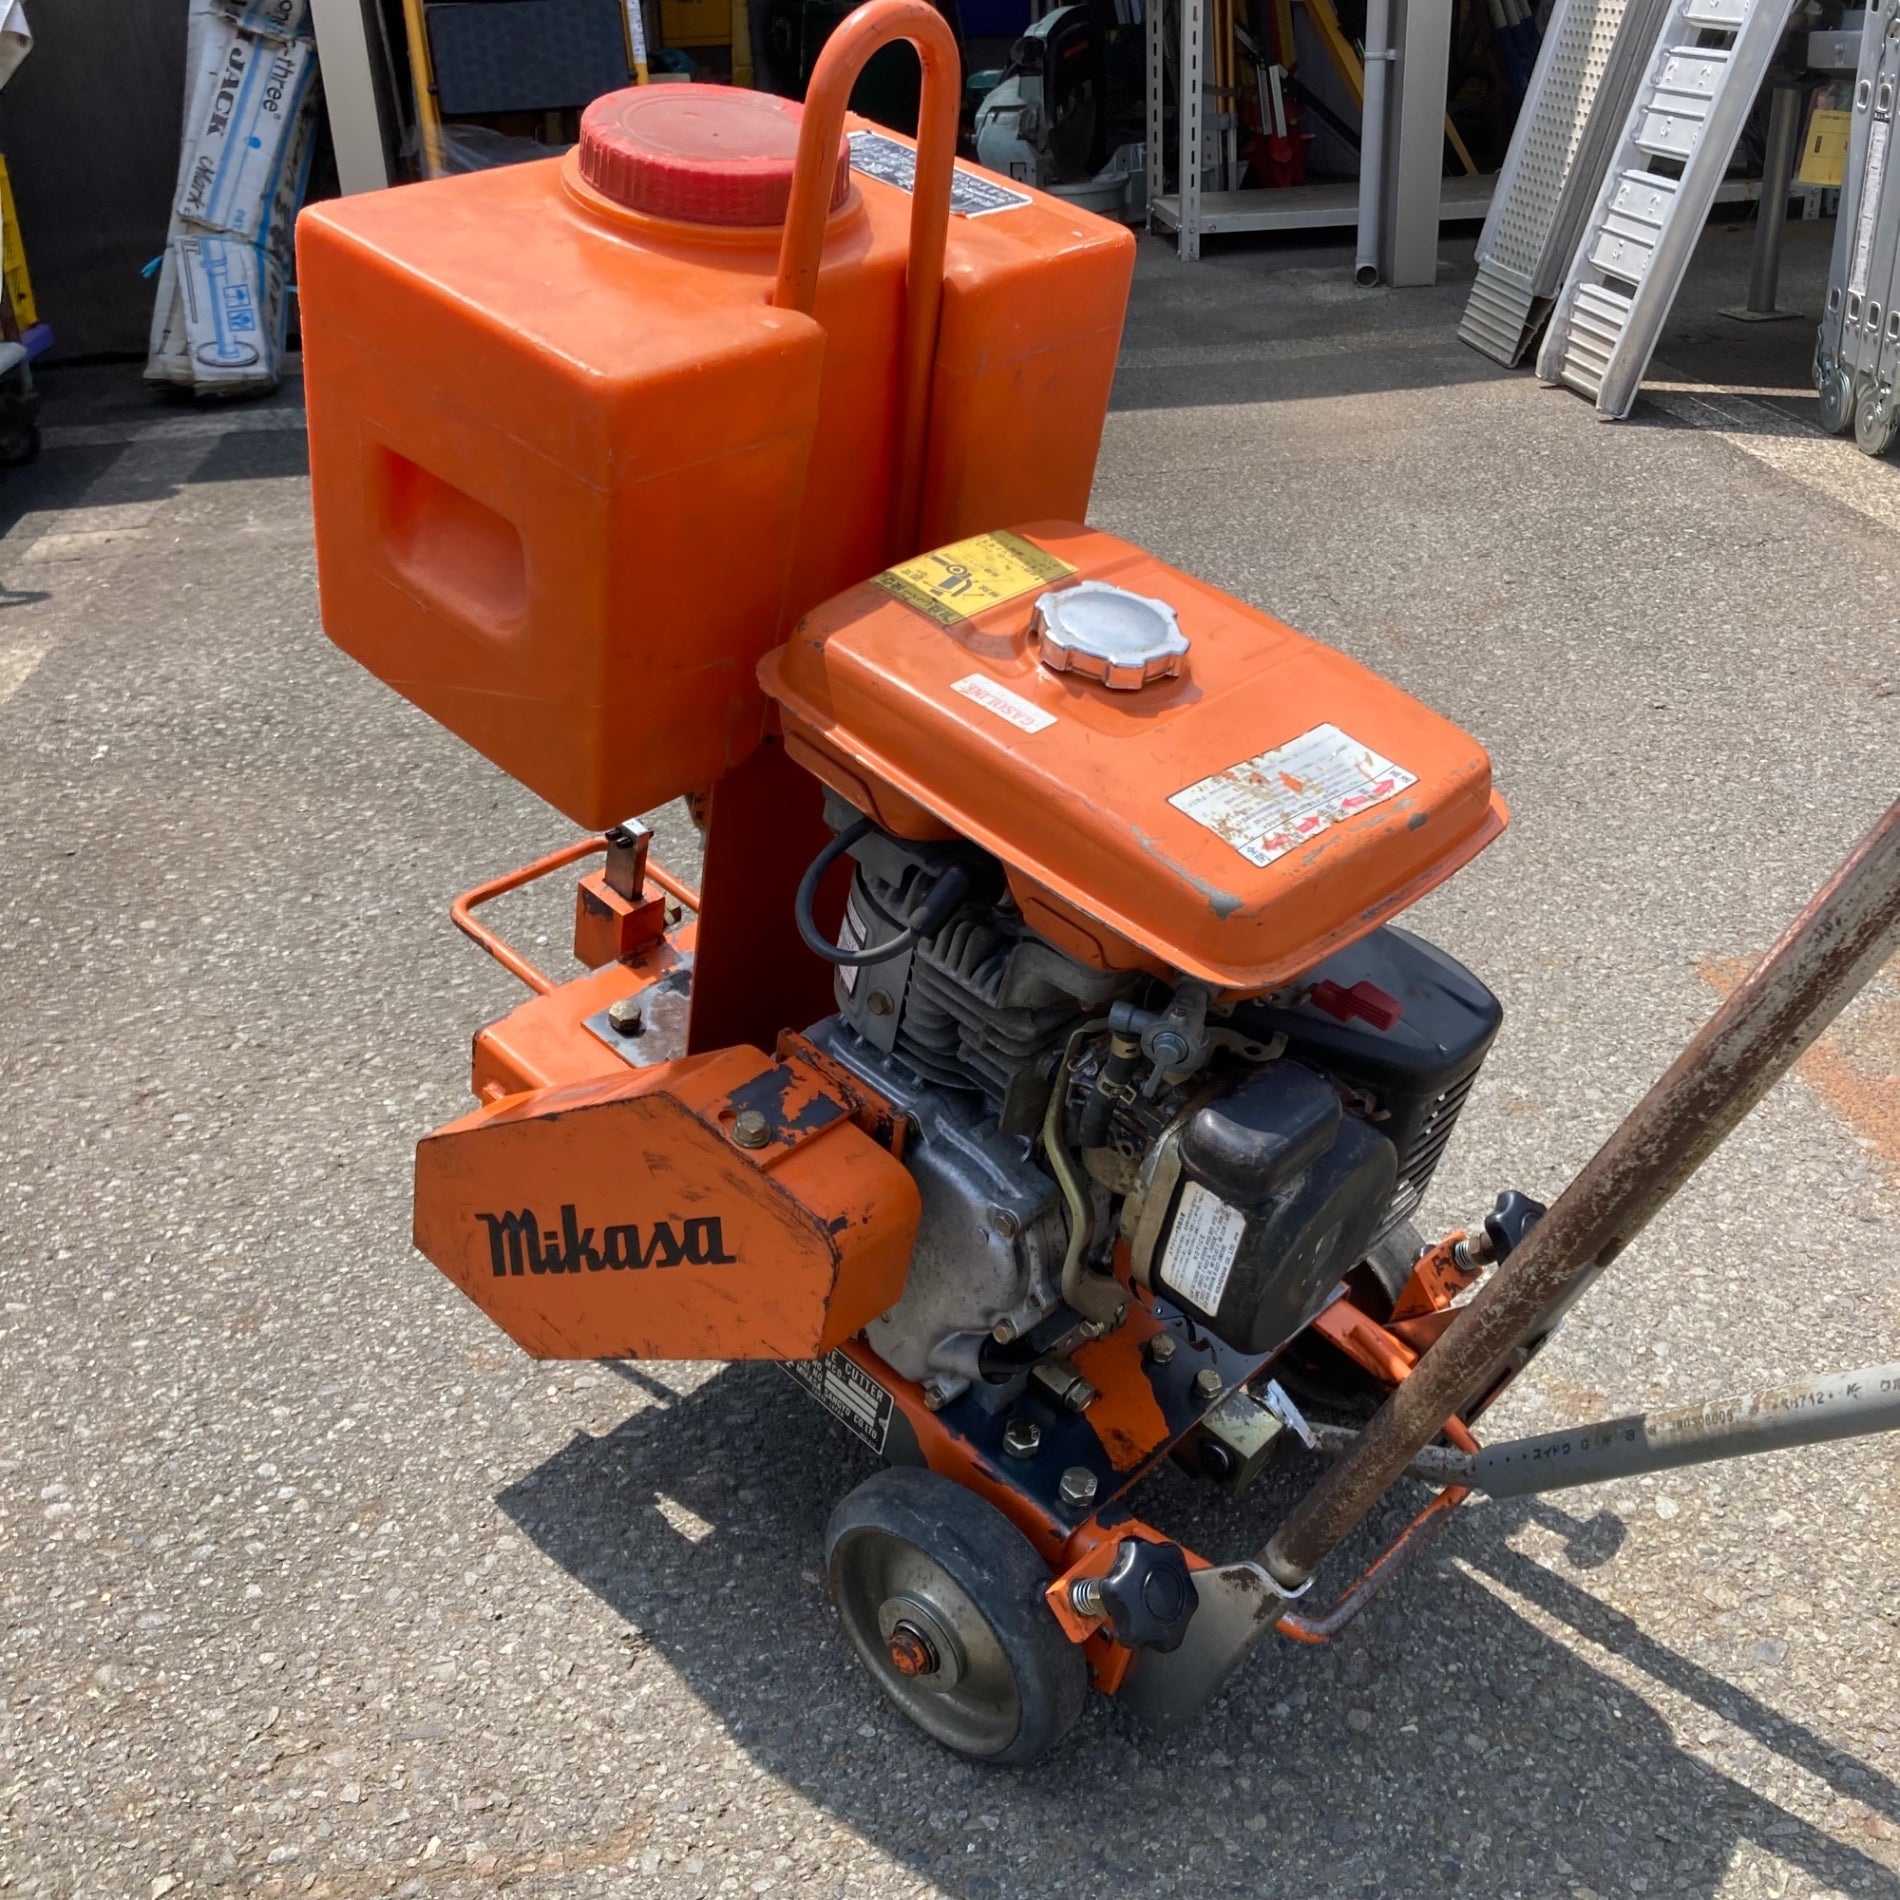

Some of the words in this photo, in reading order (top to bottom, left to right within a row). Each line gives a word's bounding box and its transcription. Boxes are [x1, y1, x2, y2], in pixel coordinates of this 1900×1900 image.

[207, 47, 245, 138] JACK
[964, 682, 1036, 727] GASOLINE
[474, 1204, 737, 1277] Mikasa
[824, 1388, 851, 1417] SANGYO
[844, 1362, 884, 1403] CUTTER
